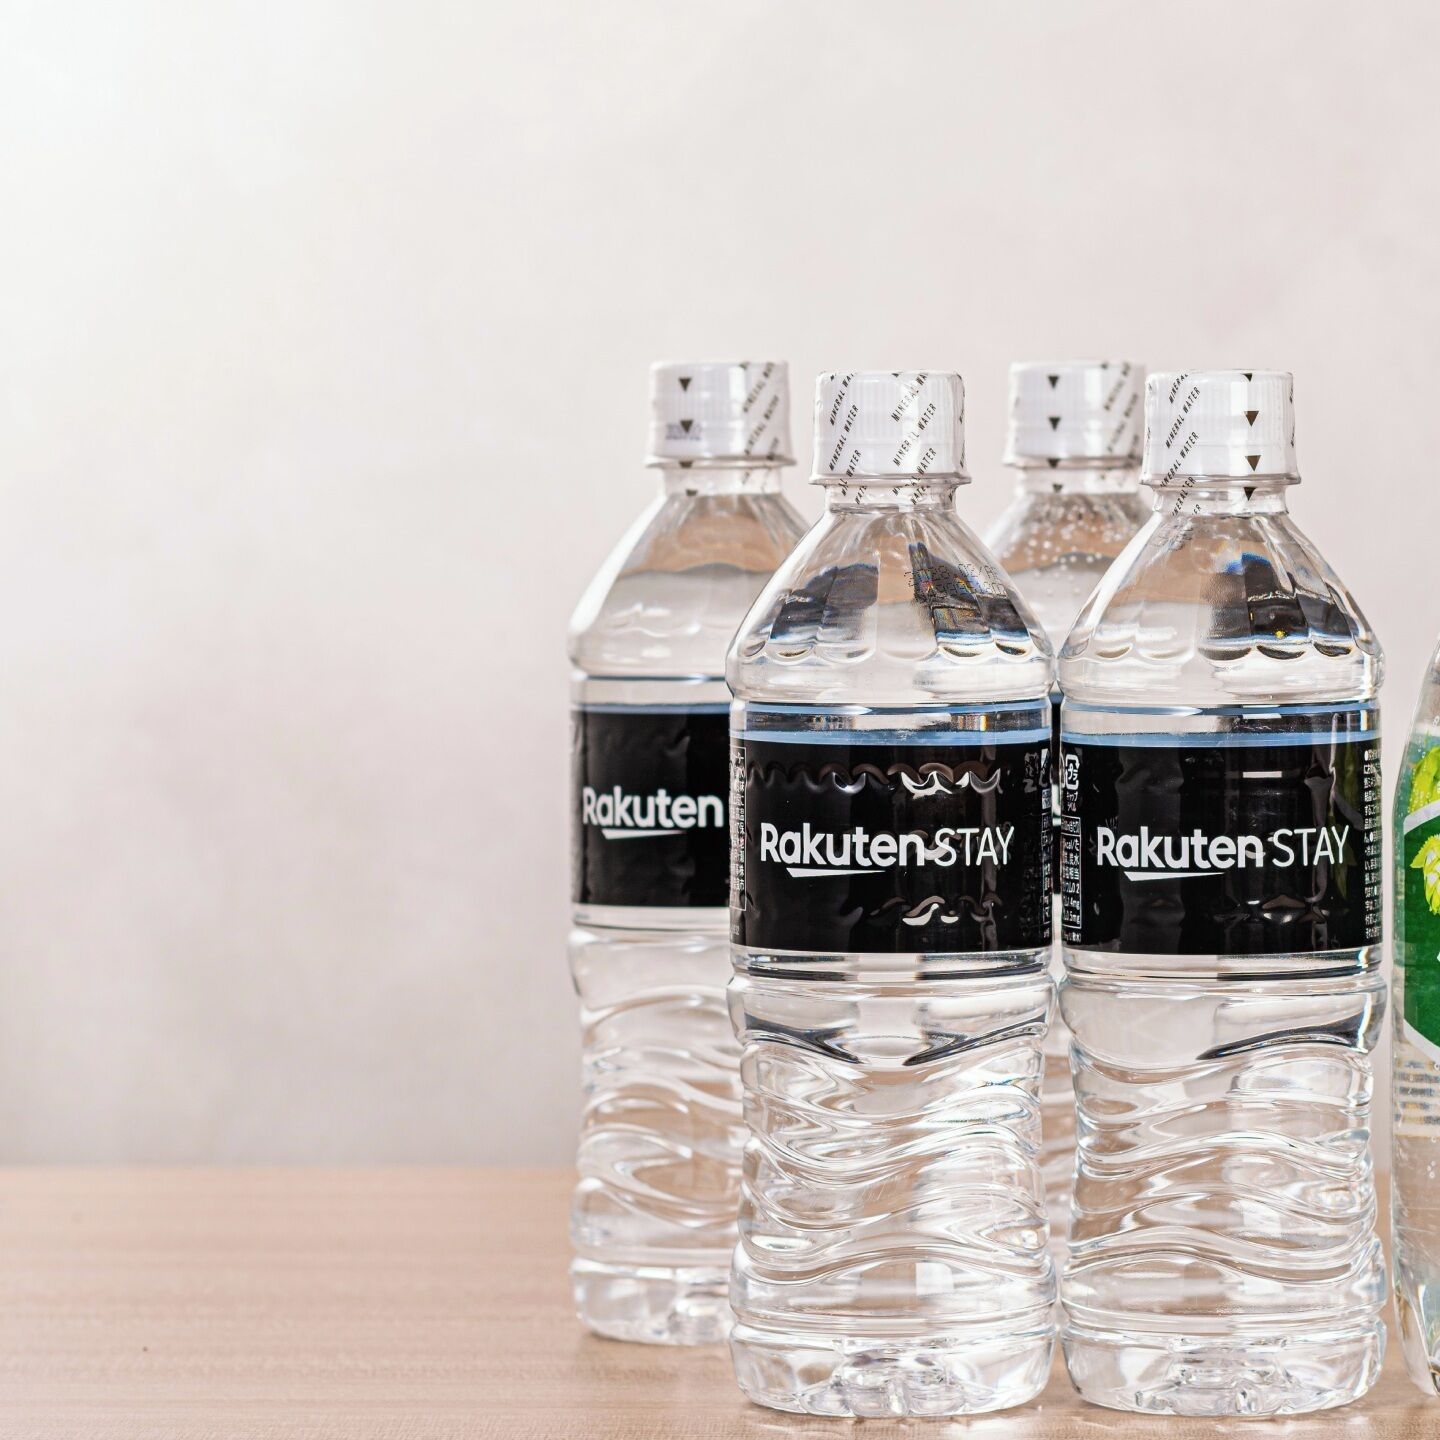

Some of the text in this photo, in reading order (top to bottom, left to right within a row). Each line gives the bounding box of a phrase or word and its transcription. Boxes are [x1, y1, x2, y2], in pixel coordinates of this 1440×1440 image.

[829, 390, 845, 426] MINERAL
[891, 385, 920, 422] MINERAL
[917, 402, 937, 431] WATER
[1165, 386, 1200, 449] MINERAL WATER
[828, 434, 847, 471] MINERAL
[843, 404, 859, 433] WATER
[1180, 431, 1199, 459] WATER
[845, 449, 862, 477] WATER
[917, 447, 937, 475] WATER
[582, 786, 724, 828] Rakuten
[760, 822, 1015, 867] Rakuten STAY
[1097, 825, 1350, 869] Rakuten STAY
